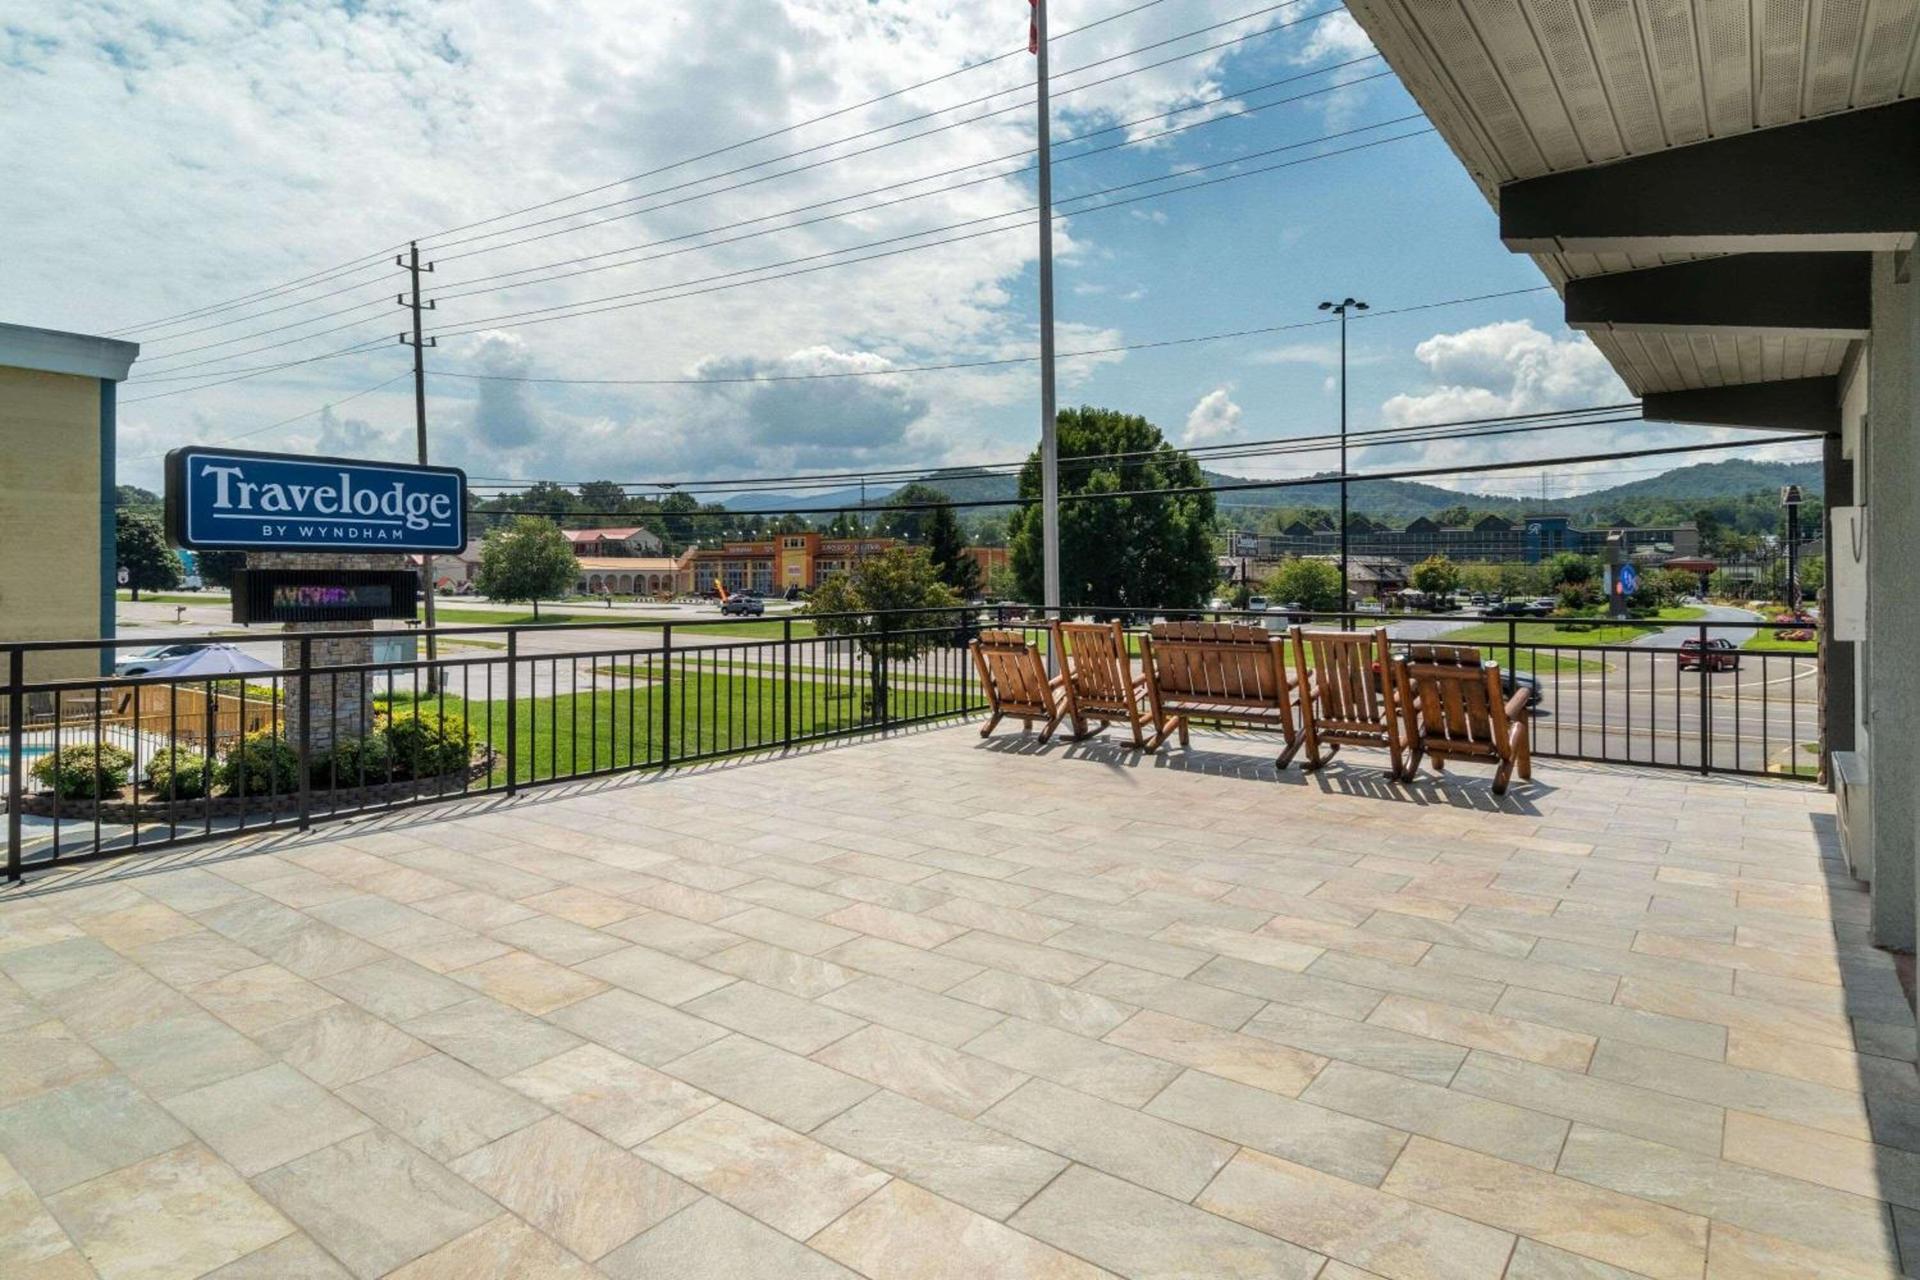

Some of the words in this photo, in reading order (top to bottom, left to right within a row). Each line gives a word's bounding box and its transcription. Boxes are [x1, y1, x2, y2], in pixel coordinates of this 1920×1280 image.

[201, 464, 451, 530] Travelodge
[263, 526, 287, 537] BY
[299, 526, 403, 540] WYNDHAM
